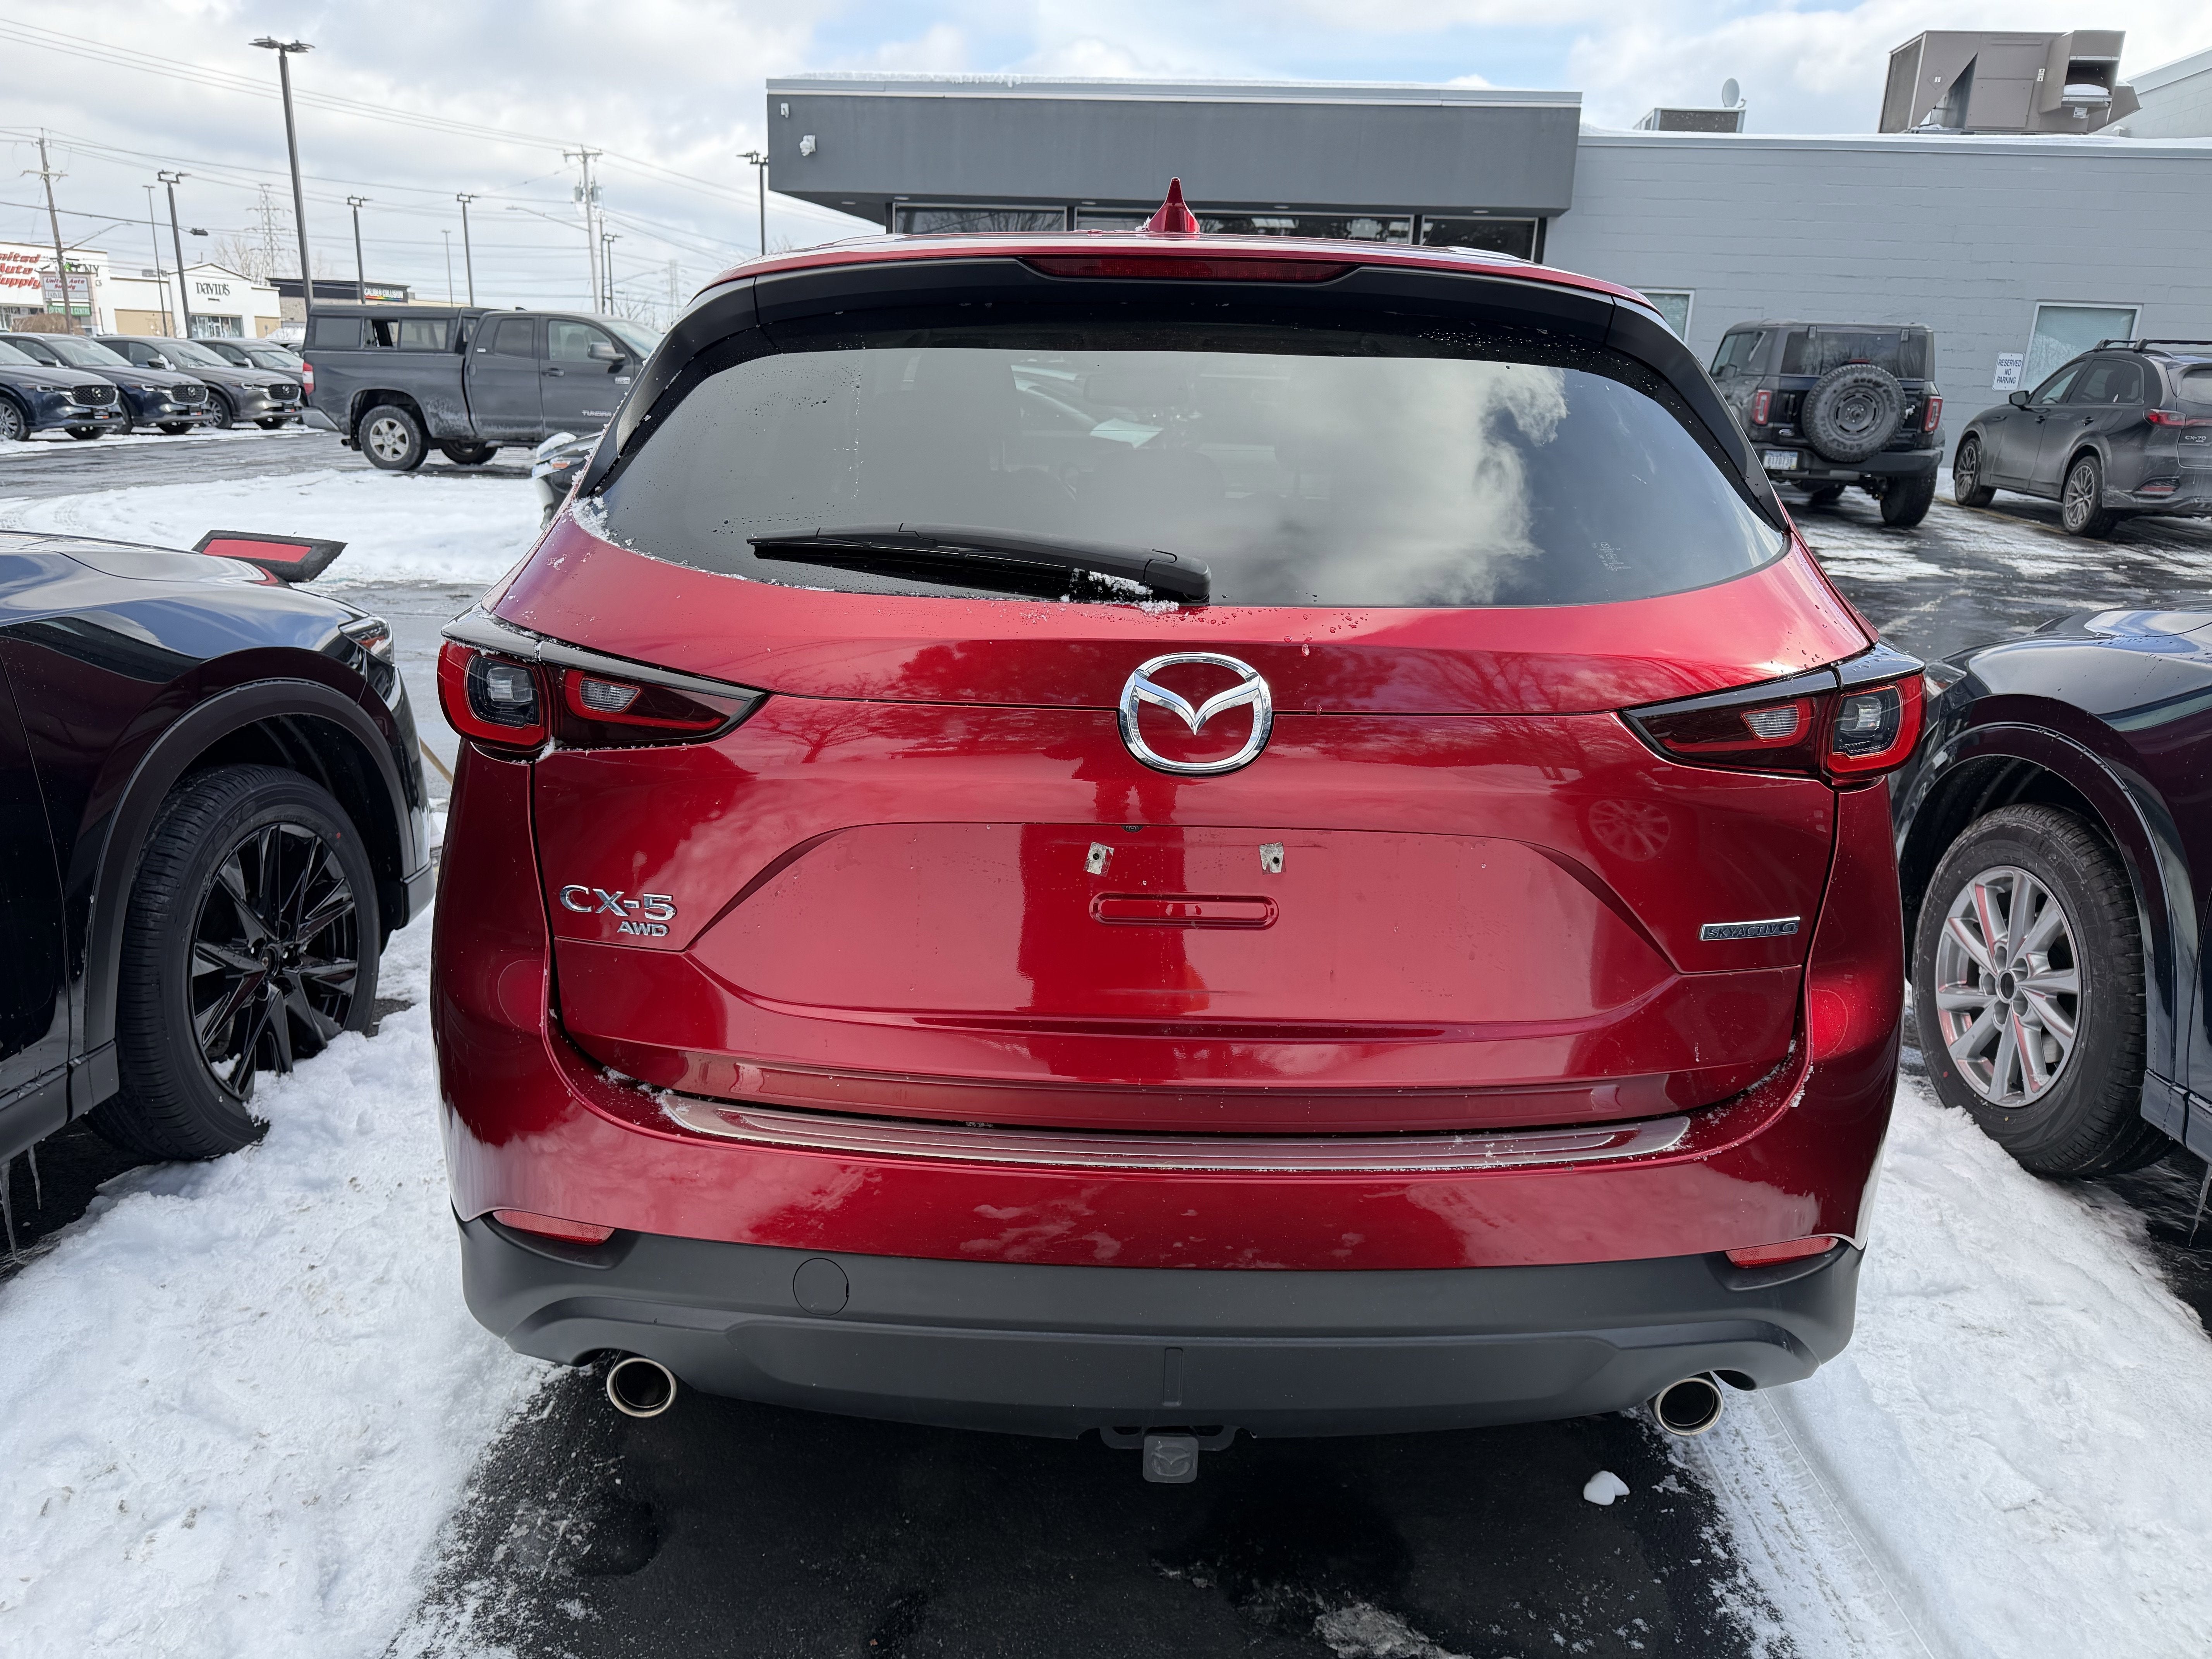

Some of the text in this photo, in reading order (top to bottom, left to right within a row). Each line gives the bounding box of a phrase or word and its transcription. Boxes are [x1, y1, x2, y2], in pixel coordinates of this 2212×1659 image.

[0, 251, 41, 263] nited
[0, 274, 41, 289] upply
[1998, 359, 2022, 367] RESERVED
[560, 884, 677, 921] CX-5
[617, 921, 670, 937] AWD
[1707, 923, 1778, 938] SKYACTIV
